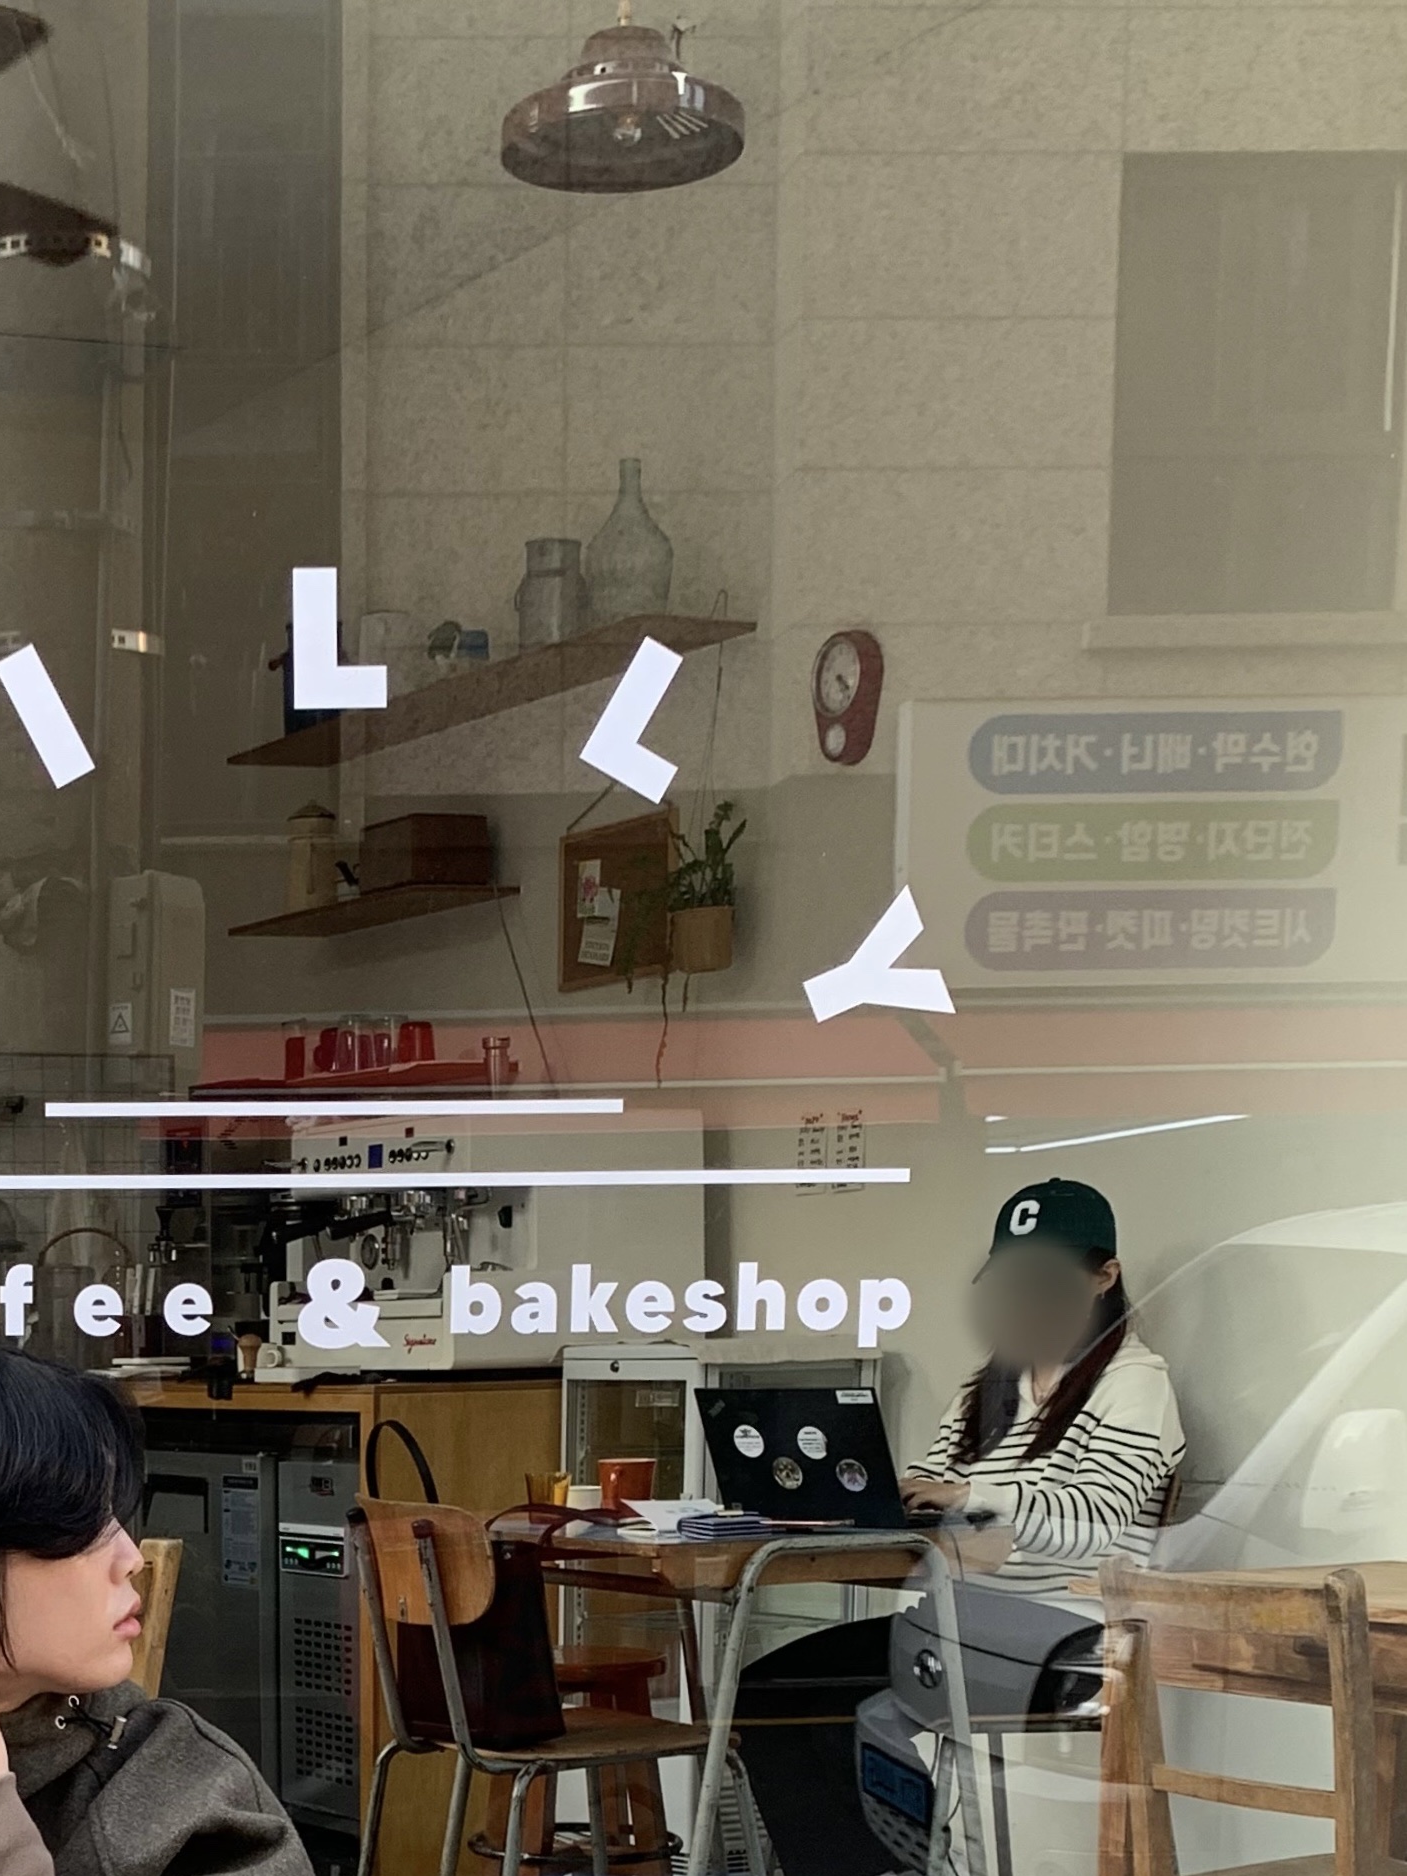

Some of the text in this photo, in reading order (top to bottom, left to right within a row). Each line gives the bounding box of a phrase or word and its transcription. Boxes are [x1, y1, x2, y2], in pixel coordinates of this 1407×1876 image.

[1008, 1199, 1041, 1235] C
[297, 1258, 391, 1349] &
[449, 1261, 912, 1348] bakeshop
